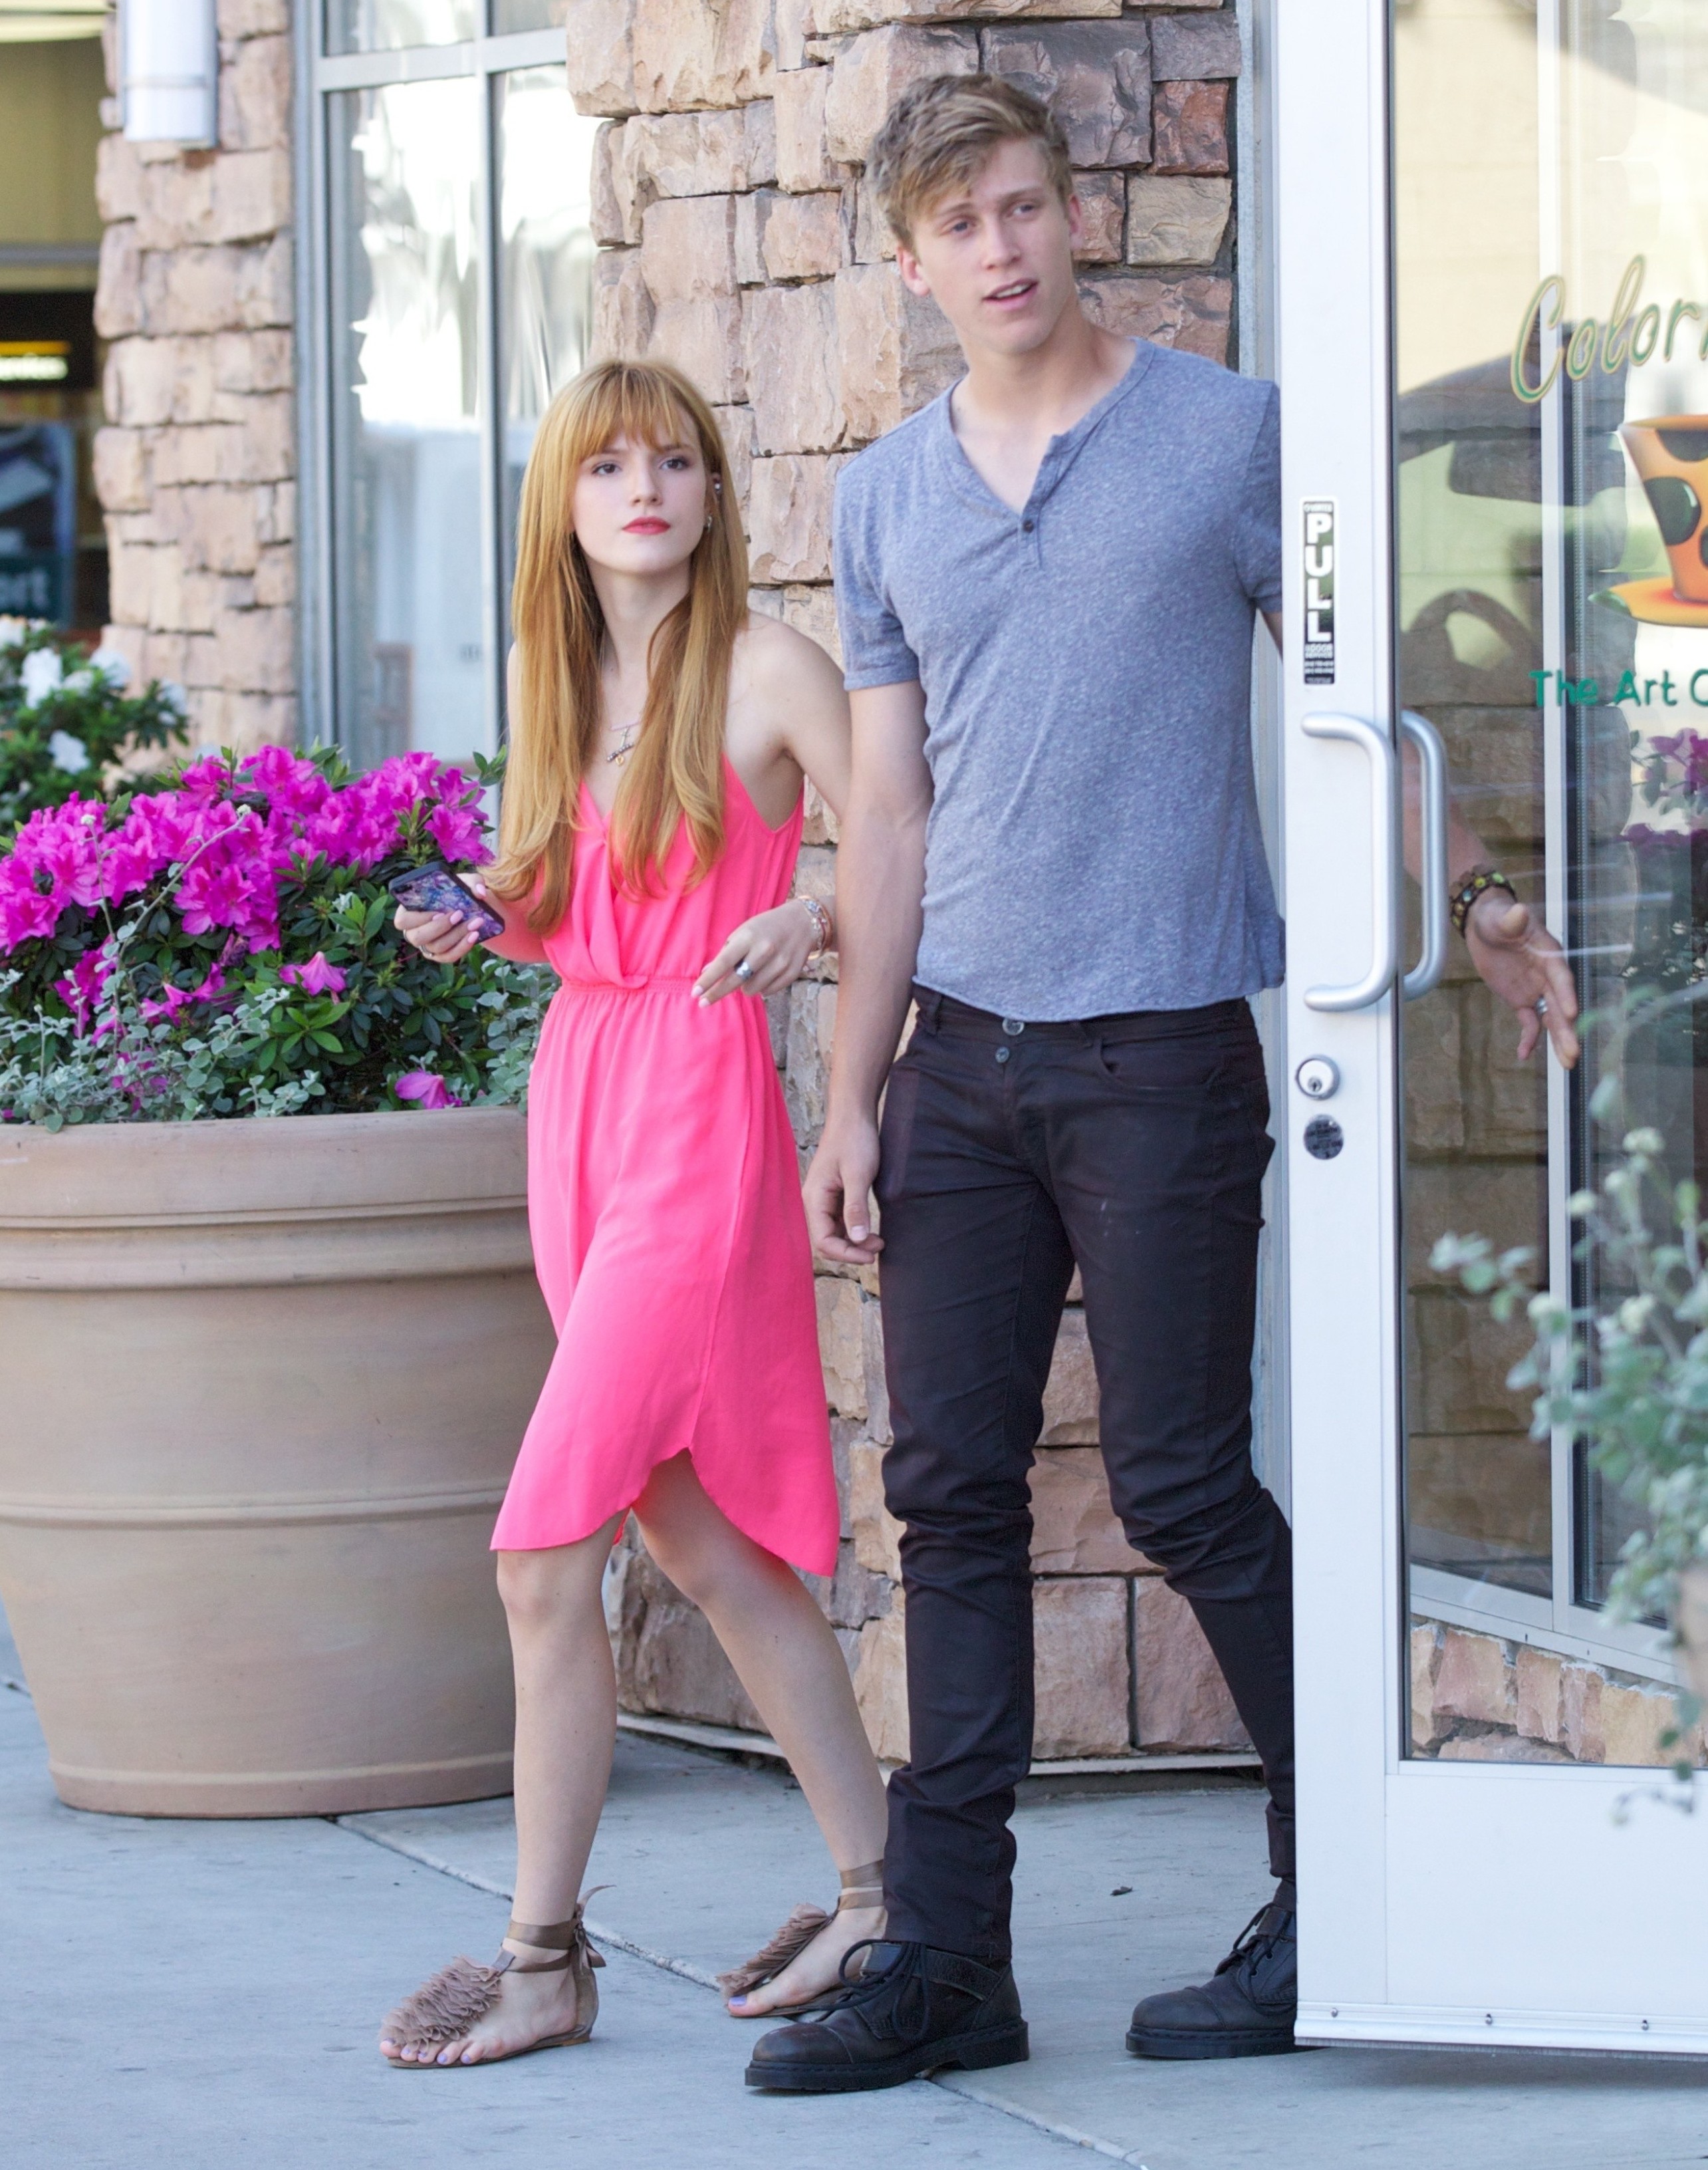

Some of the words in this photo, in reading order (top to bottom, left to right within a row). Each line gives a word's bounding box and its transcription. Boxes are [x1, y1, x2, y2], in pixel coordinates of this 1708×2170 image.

[1511, 254, 1708, 403] Color
[1305, 513, 1332, 642] PULL
[1529, 669, 1598, 707] The
[1613, 670, 1678, 706] Art
